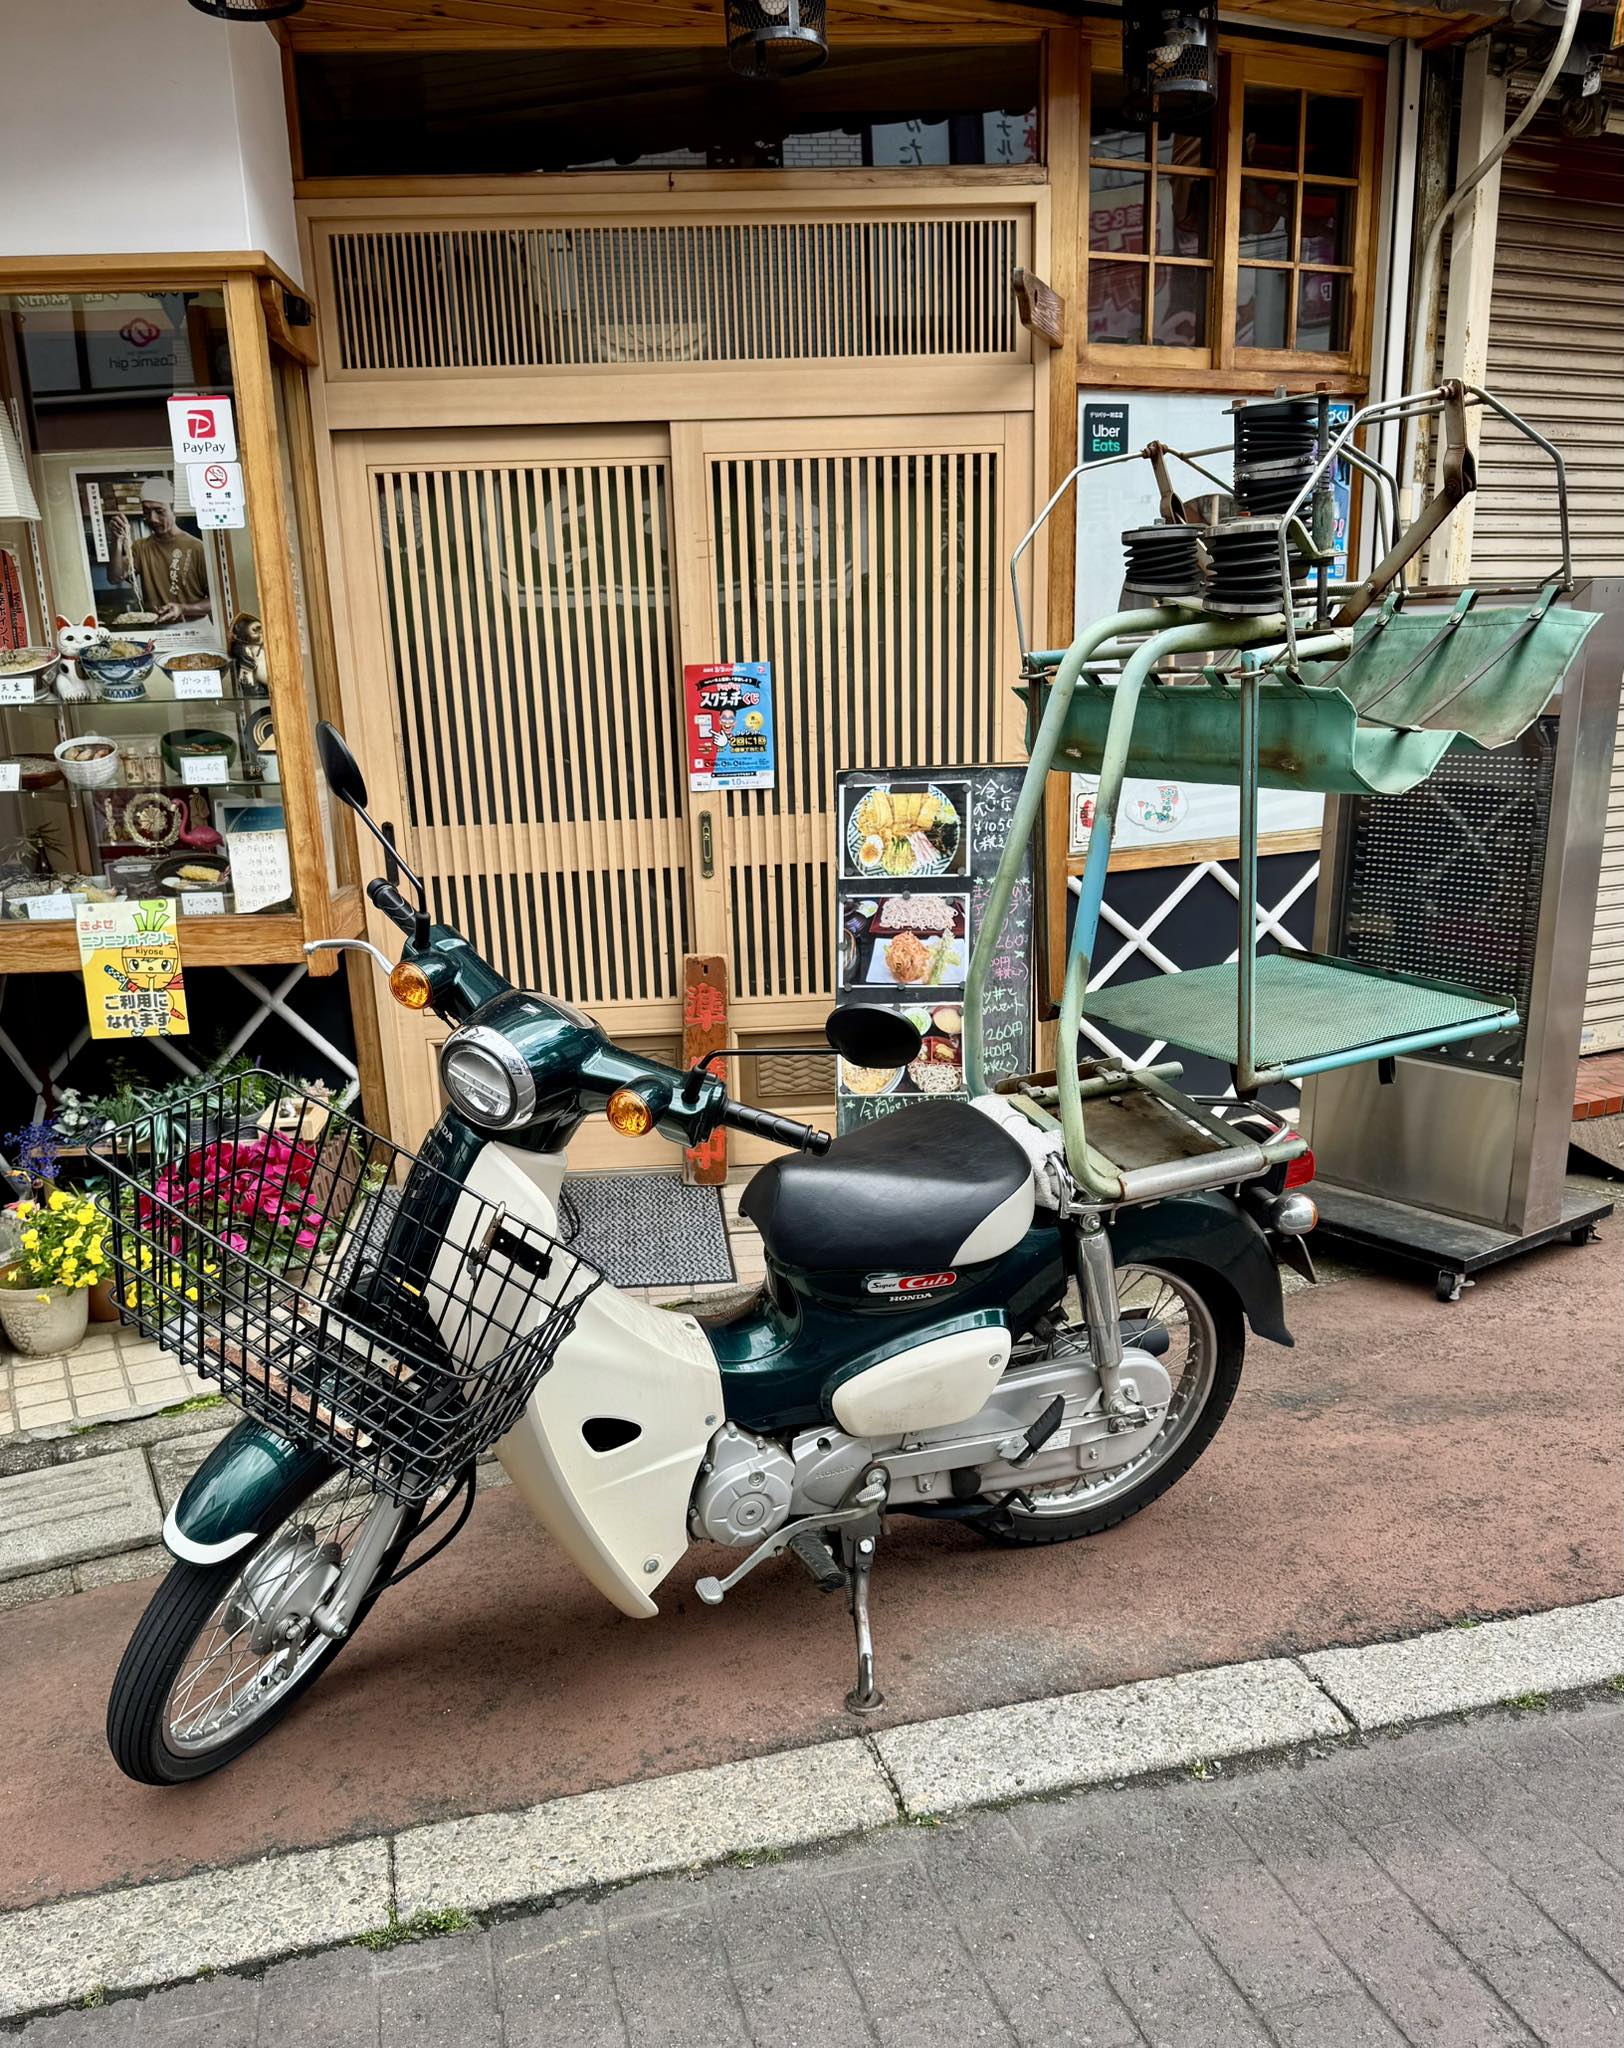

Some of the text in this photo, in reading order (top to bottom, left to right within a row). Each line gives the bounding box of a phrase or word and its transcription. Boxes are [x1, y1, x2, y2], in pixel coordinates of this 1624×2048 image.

[1092, 424, 1121, 438] Uber
[182, 442, 226, 455] PayPay
[1092, 439, 1121, 452] Eats
[700, 691, 760, 707] スクラッチくじ
[974, 779, 1013, 799] 冷し
[79, 919, 114, 932] きよせ
[81, 933, 174, 948] ニンニンポイント
[135, 948, 164, 956] kiyose
[104, 993, 169, 1010] ご利用に
[106, 1011, 170, 1029] なれます
[906, 1275, 949, 1288] Cub
[889, 1292, 933, 1302] HONDA
